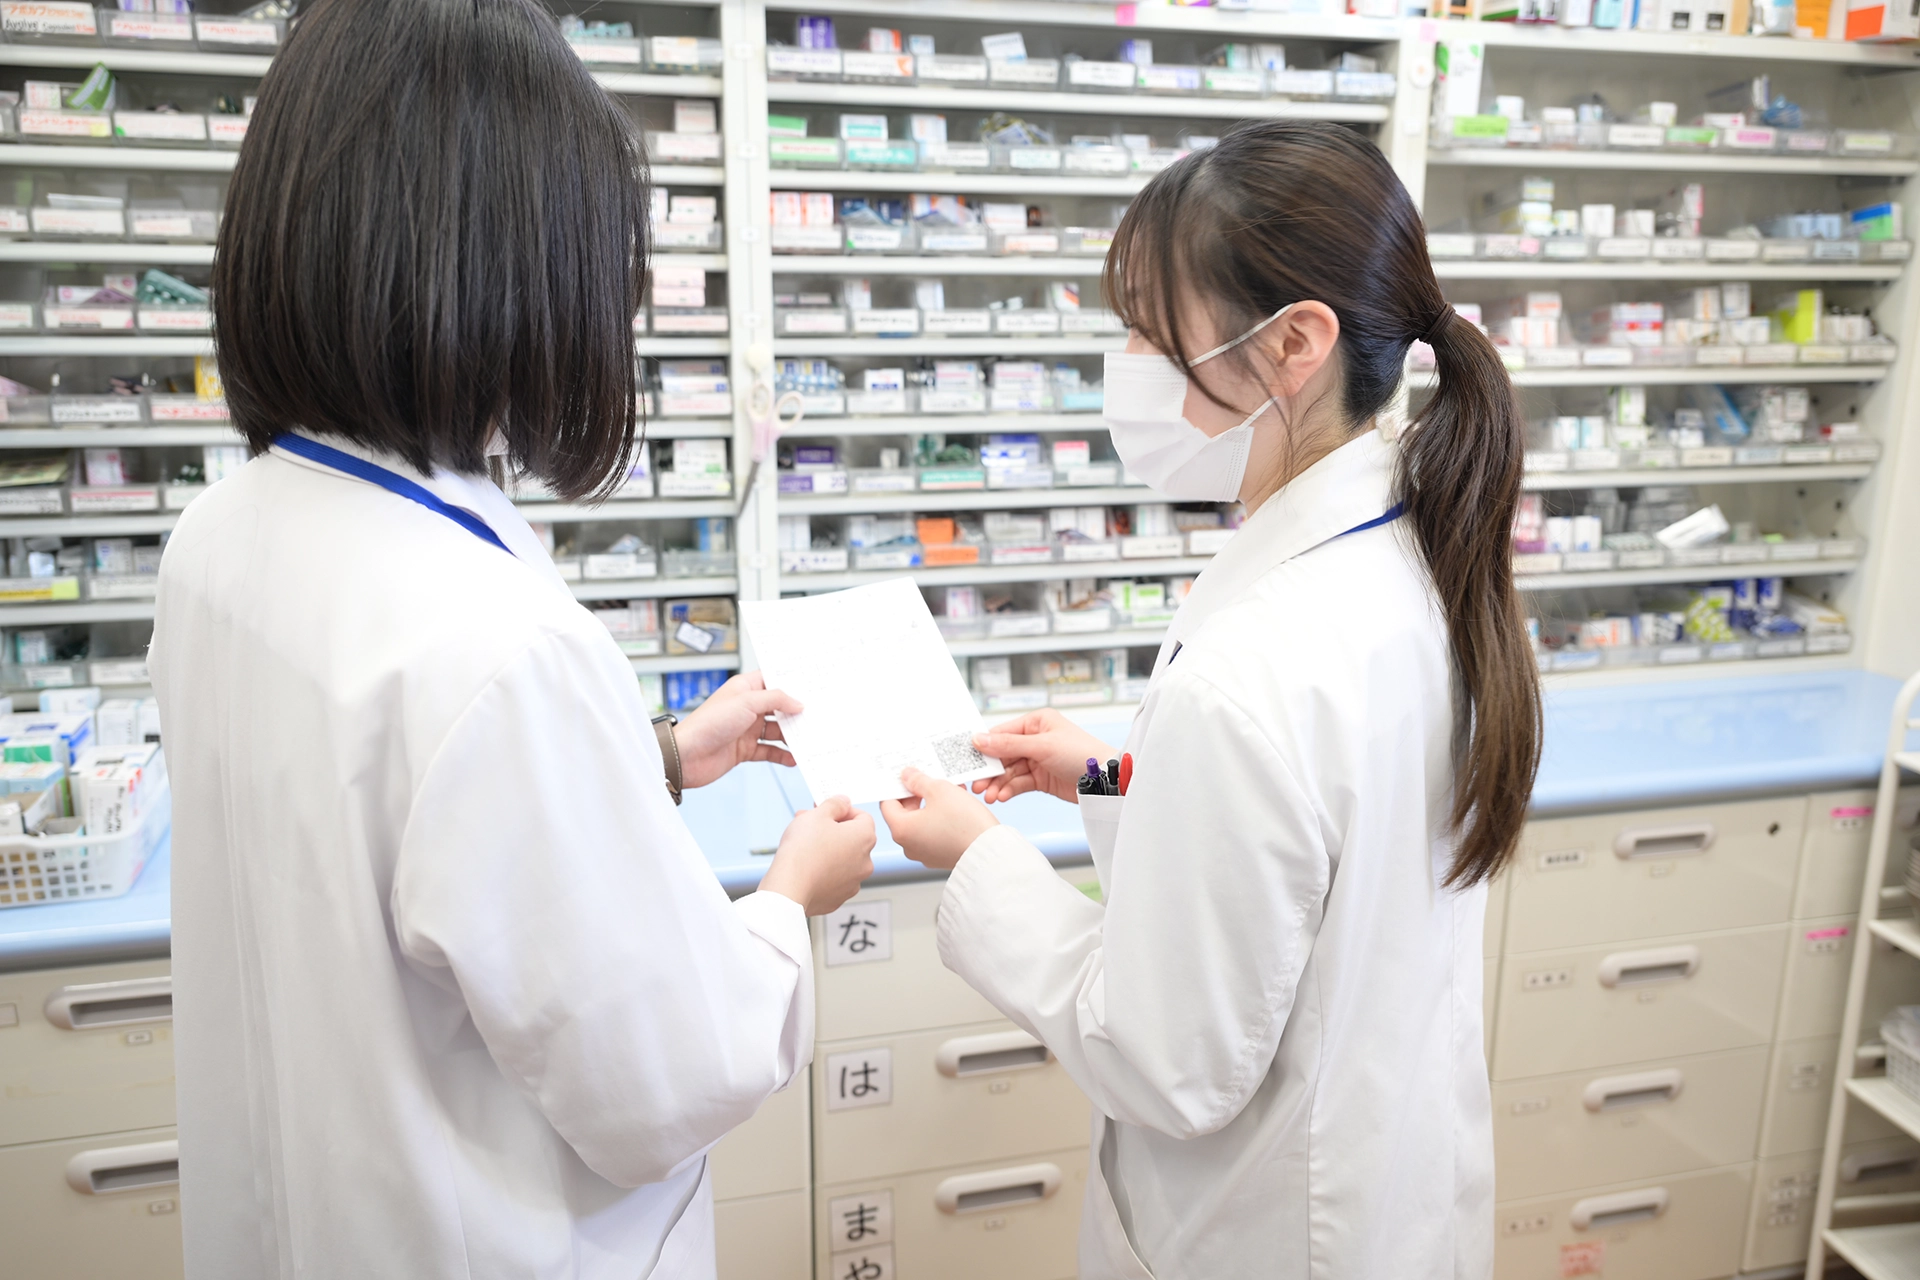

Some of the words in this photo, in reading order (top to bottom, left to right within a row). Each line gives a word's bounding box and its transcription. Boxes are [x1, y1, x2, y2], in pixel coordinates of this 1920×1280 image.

[839, 914, 878, 953] な
[839, 1061, 879, 1099] は
[843, 1203, 879, 1242] ま
[845, 1257, 882, 1280] や
